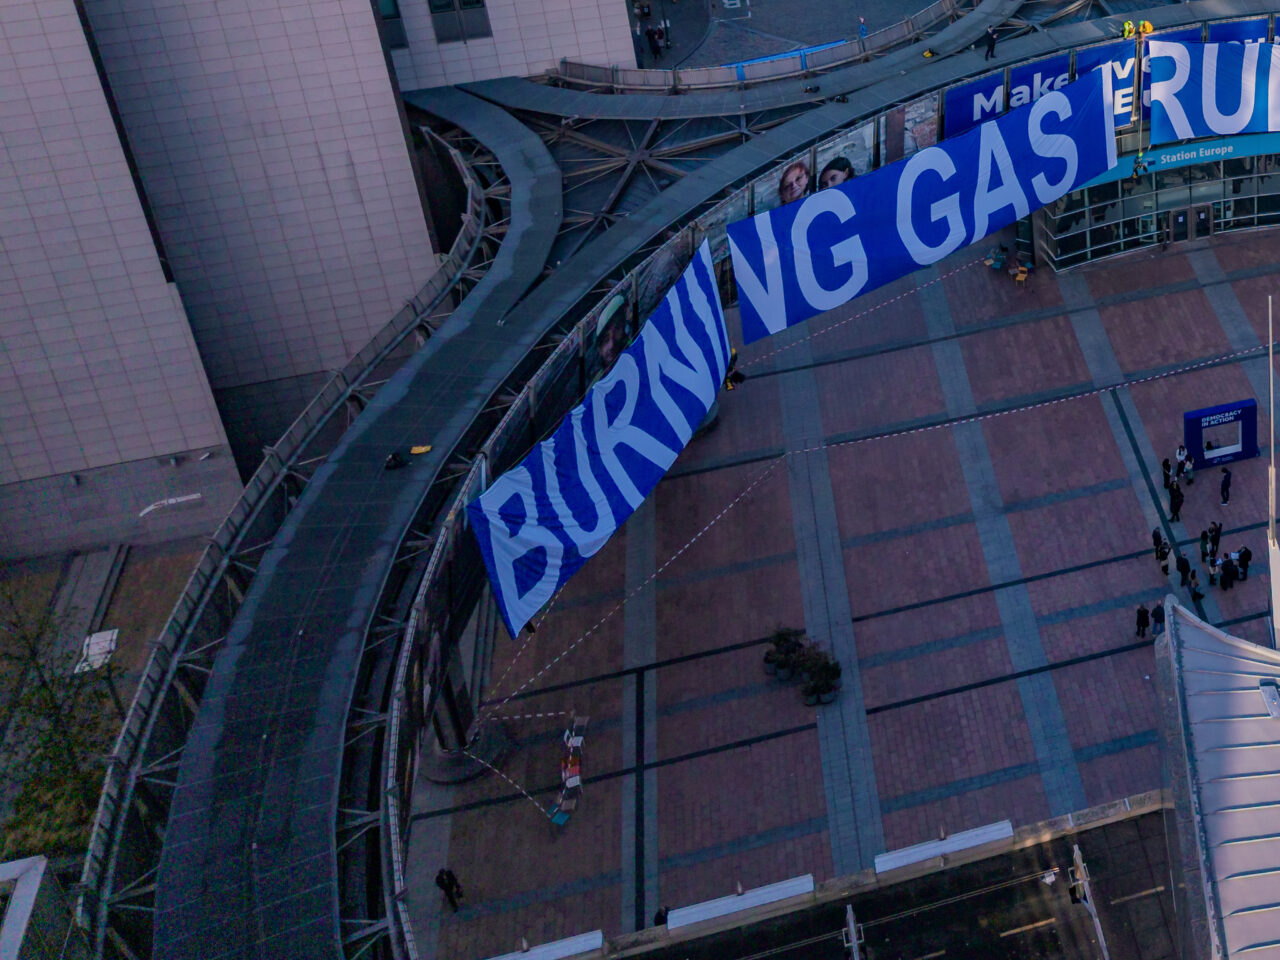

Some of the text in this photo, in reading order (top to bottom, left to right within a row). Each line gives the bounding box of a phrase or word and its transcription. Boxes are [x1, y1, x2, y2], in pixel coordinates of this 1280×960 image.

[1160, 145, 1234, 164] Station Europe
[479, 188, 869, 640] BURNING
[896, 90, 1079, 266] GAS
[1202, 409, 1242, 423] DEMOCRACY
[1210, 416, 1235, 425] ACTION
